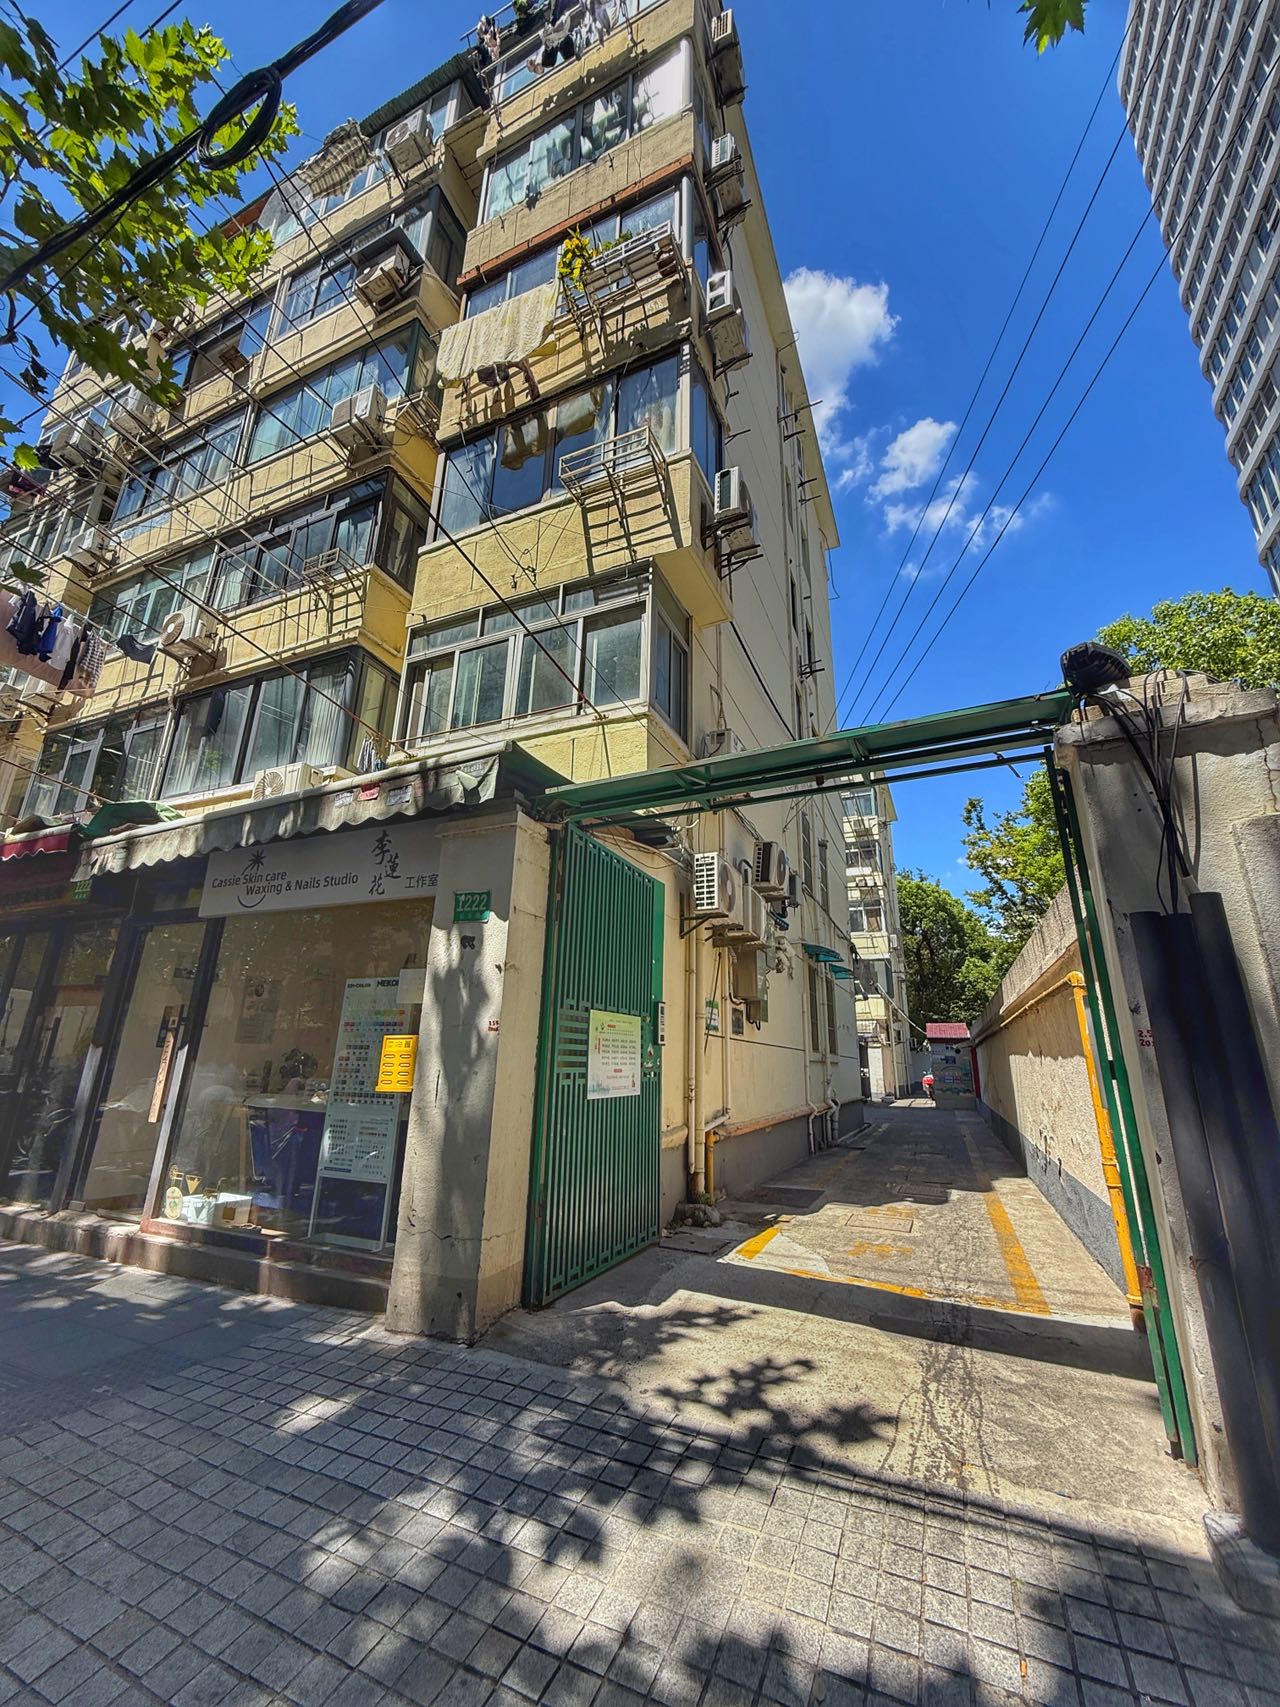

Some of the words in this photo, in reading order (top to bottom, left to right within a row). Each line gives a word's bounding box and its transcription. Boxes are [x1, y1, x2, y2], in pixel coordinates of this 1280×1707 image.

[212, 874, 241, 889] Cassie
[242, 872, 263, 885] Skin
[265, 871, 287, 882] care
[246, 882, 283, 896] Waxing
[285, 880, 292, 891] &
[294, 876, 321, 891] Nails
[323, 872, 359, 888] Studio
[404, 873, 439, 889] 工作室
[456, 894, 488, 912] 1222
